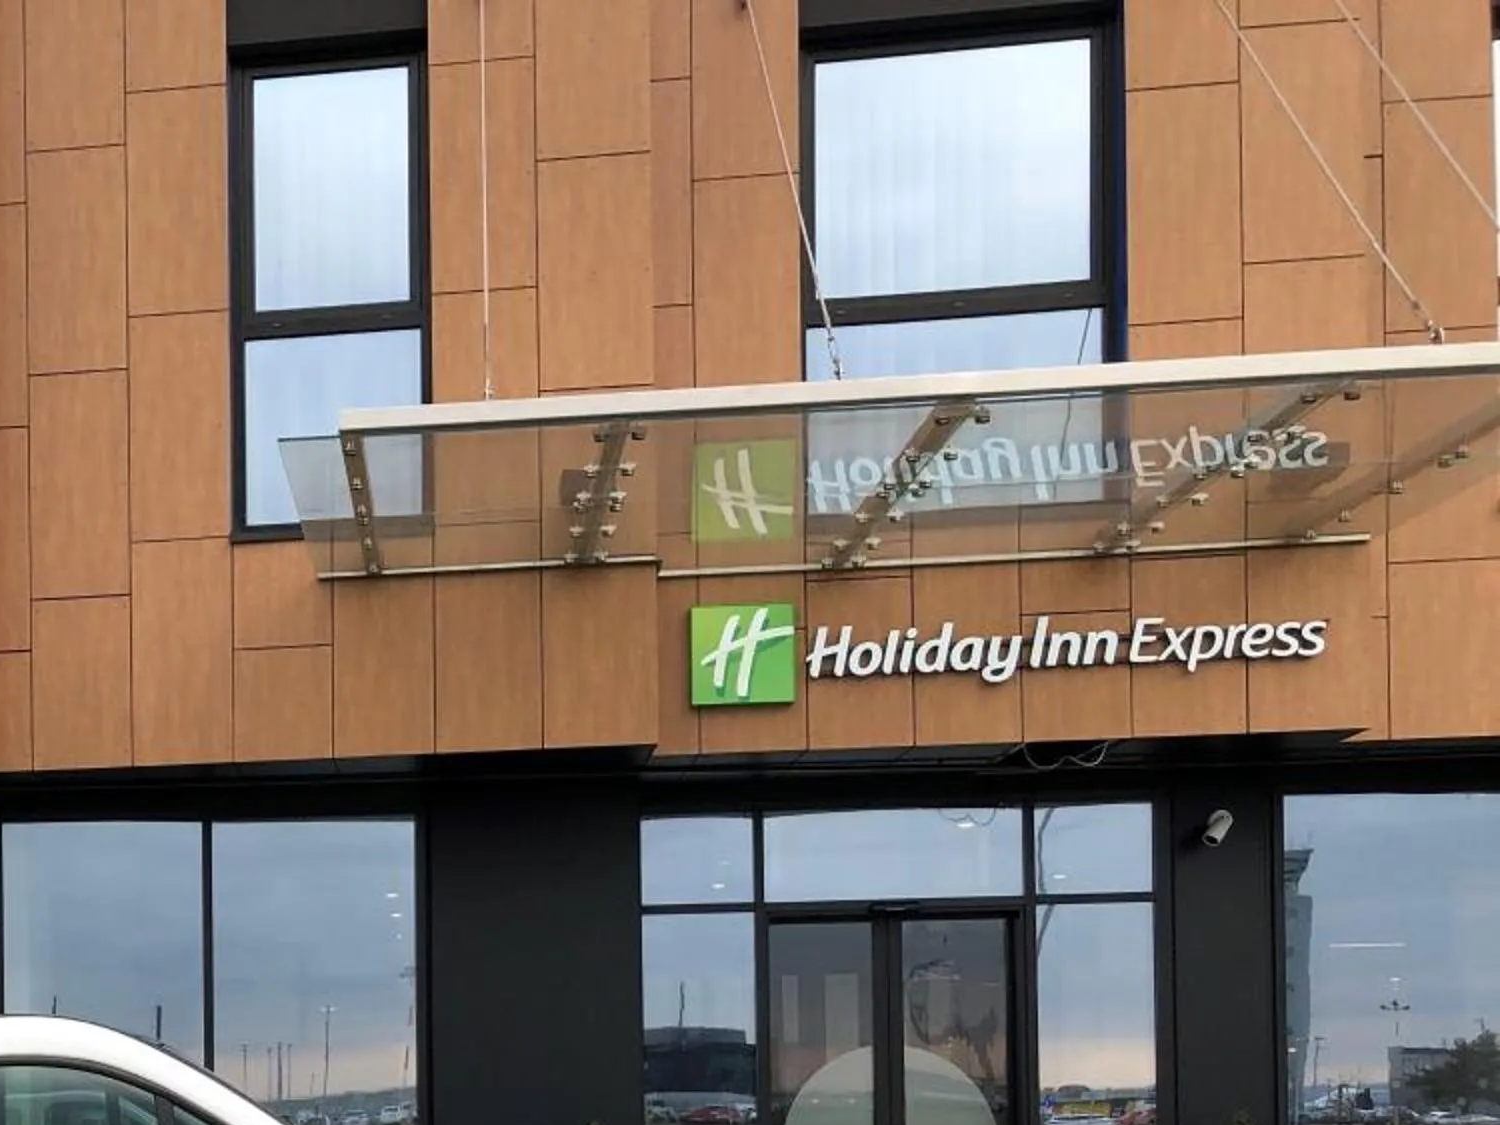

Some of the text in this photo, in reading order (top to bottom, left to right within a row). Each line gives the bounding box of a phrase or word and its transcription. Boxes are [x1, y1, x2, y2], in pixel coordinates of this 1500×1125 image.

[805, 615, 1327, 683] Holiday Inn Express
